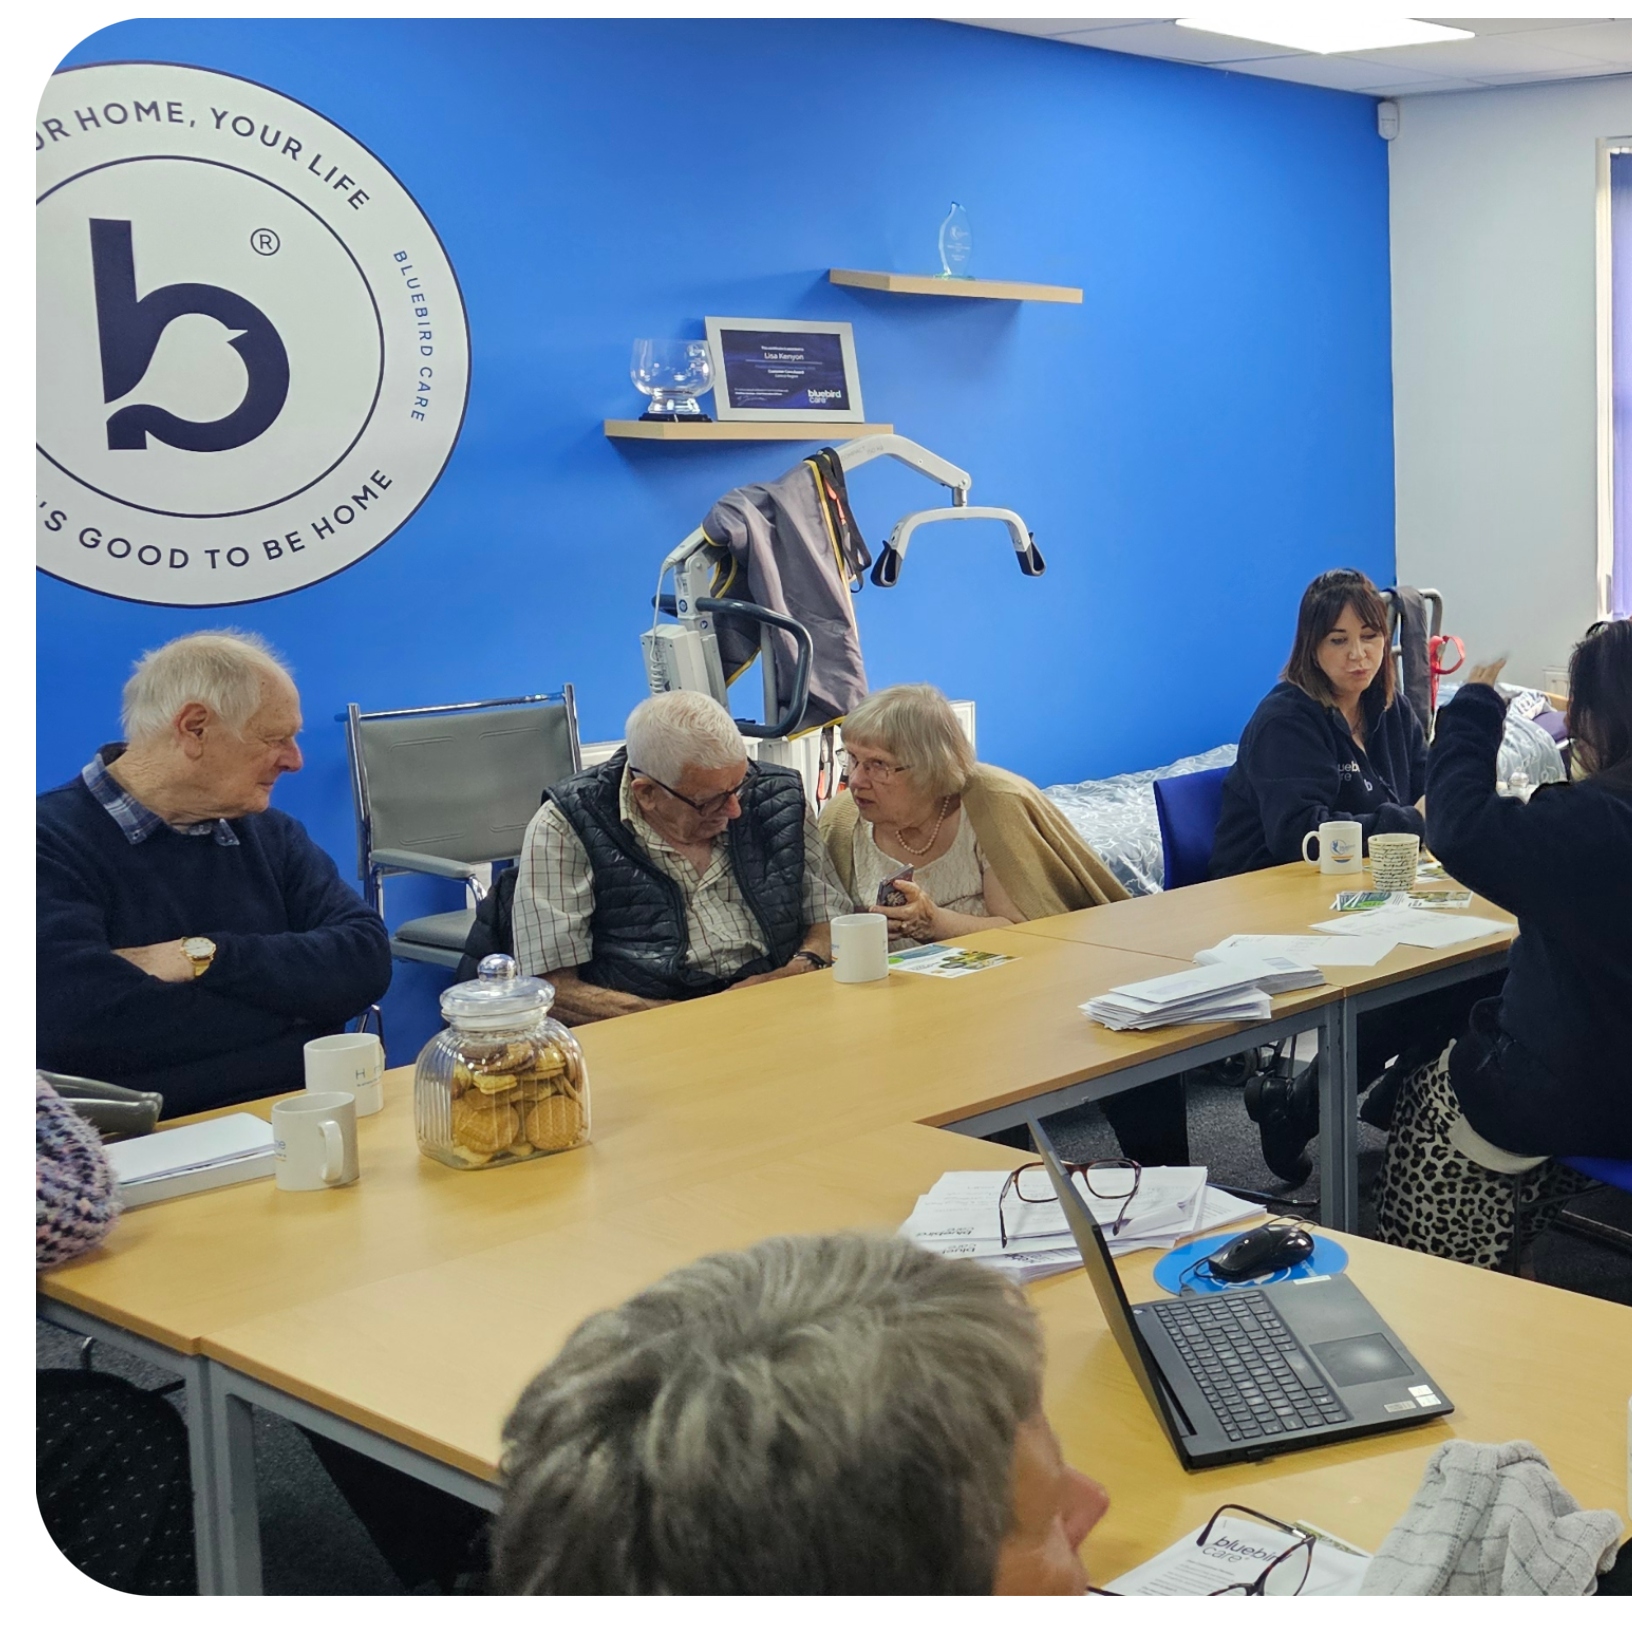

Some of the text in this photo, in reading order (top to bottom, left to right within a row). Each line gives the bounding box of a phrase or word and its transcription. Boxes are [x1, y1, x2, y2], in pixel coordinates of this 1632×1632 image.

[75, 101, 195, 131] HOME,
[211, 107, 302, 160] YOUR
[308, 154, 370, 210] LIFE
[393, 250, 433, 421] BLUEBIRD CARE
[764, 352, 804, 362] Lisa Kenyon
[808, 389, 841, 399] bluebird
[79, 527, 189, 569] GOOD
[204, 546, 250, 569] TO
[262, 530, 305, 560] BE
[311, 469, 393, 540] HOME
[1203, 1546, 1242, 1563] care
